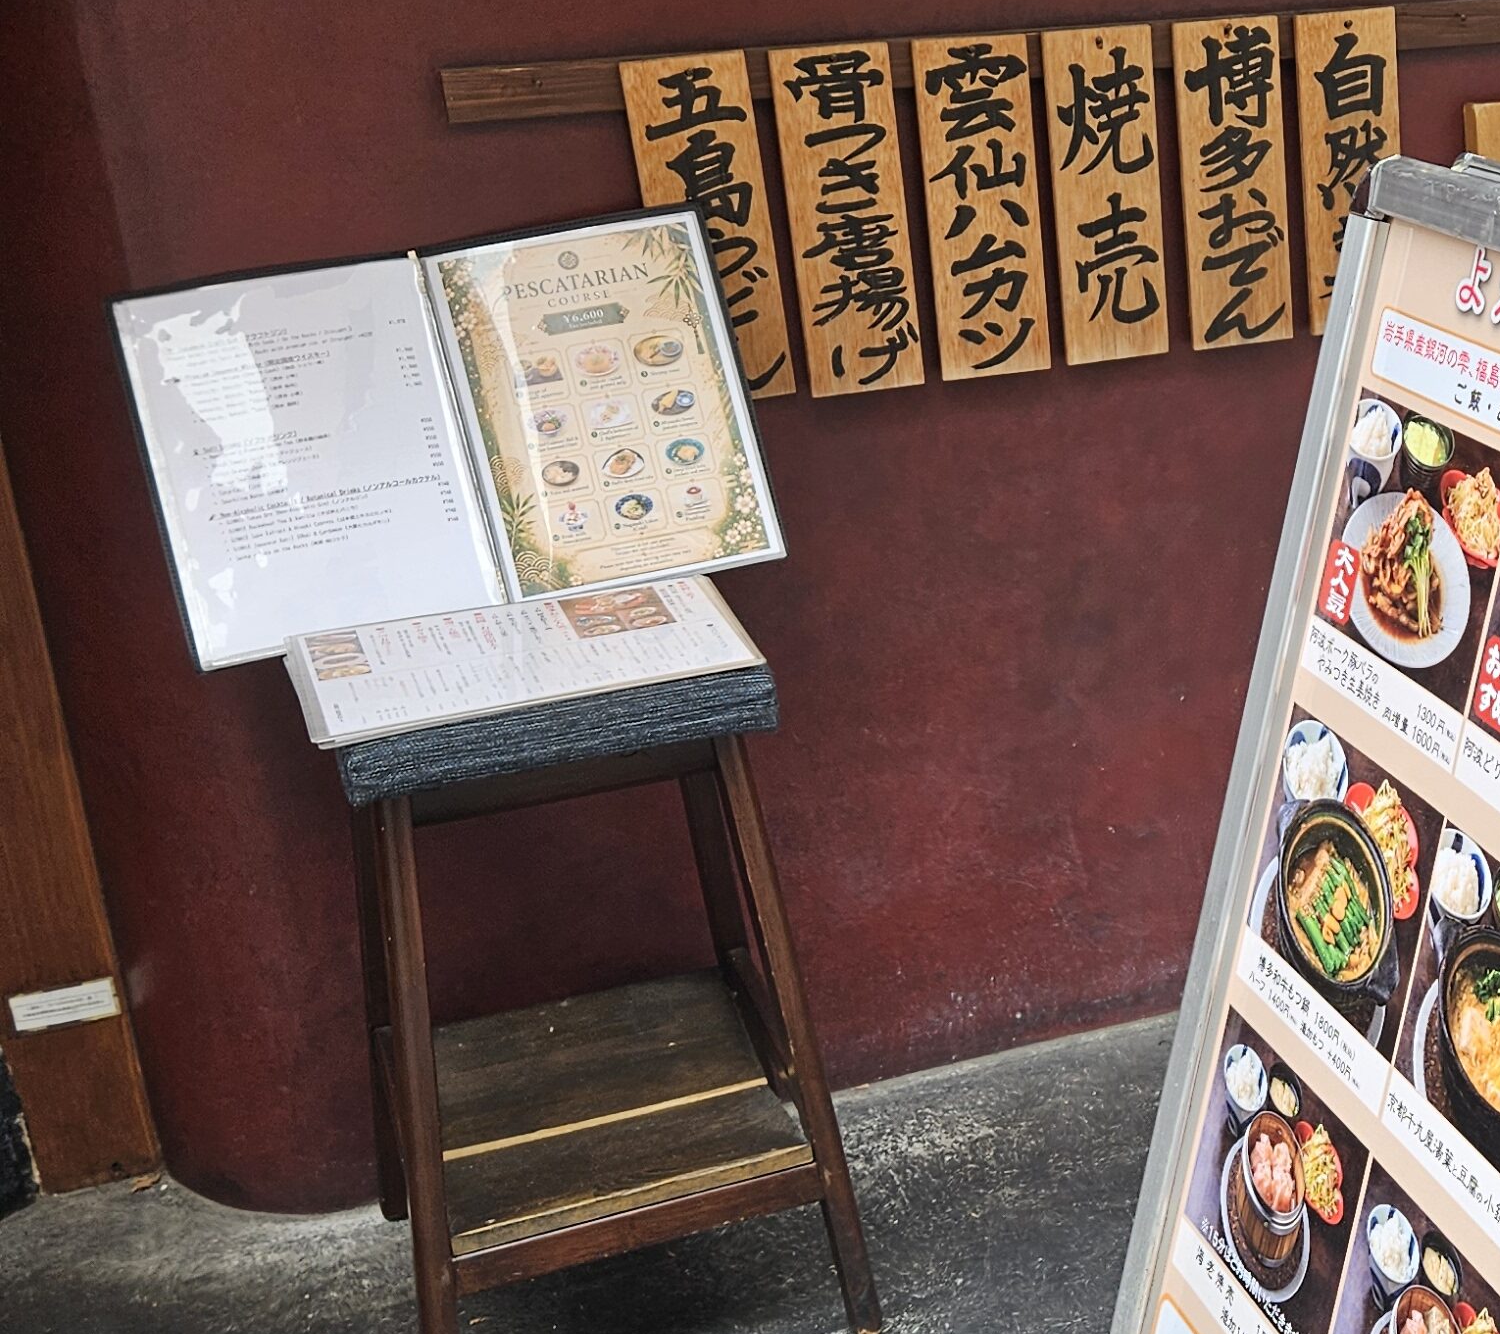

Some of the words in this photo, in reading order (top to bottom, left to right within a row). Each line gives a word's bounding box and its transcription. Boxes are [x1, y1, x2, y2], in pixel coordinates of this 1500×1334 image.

[784, 50, 919, 385] 骨つき唐揚げ
[925, 43, 1036, 370] 雲仙ハムカツ
[1057, 46, 1160, 324] 焼売
[1185, 26, 1286, 343] 博多おでん
[504, 263, 649, 300] PESCATARIAN
[548, 290, 611, 307] COURSE
[1324, 541, 1358, 621] 大人気
[1416, 703, 1446, 735] 1300円
